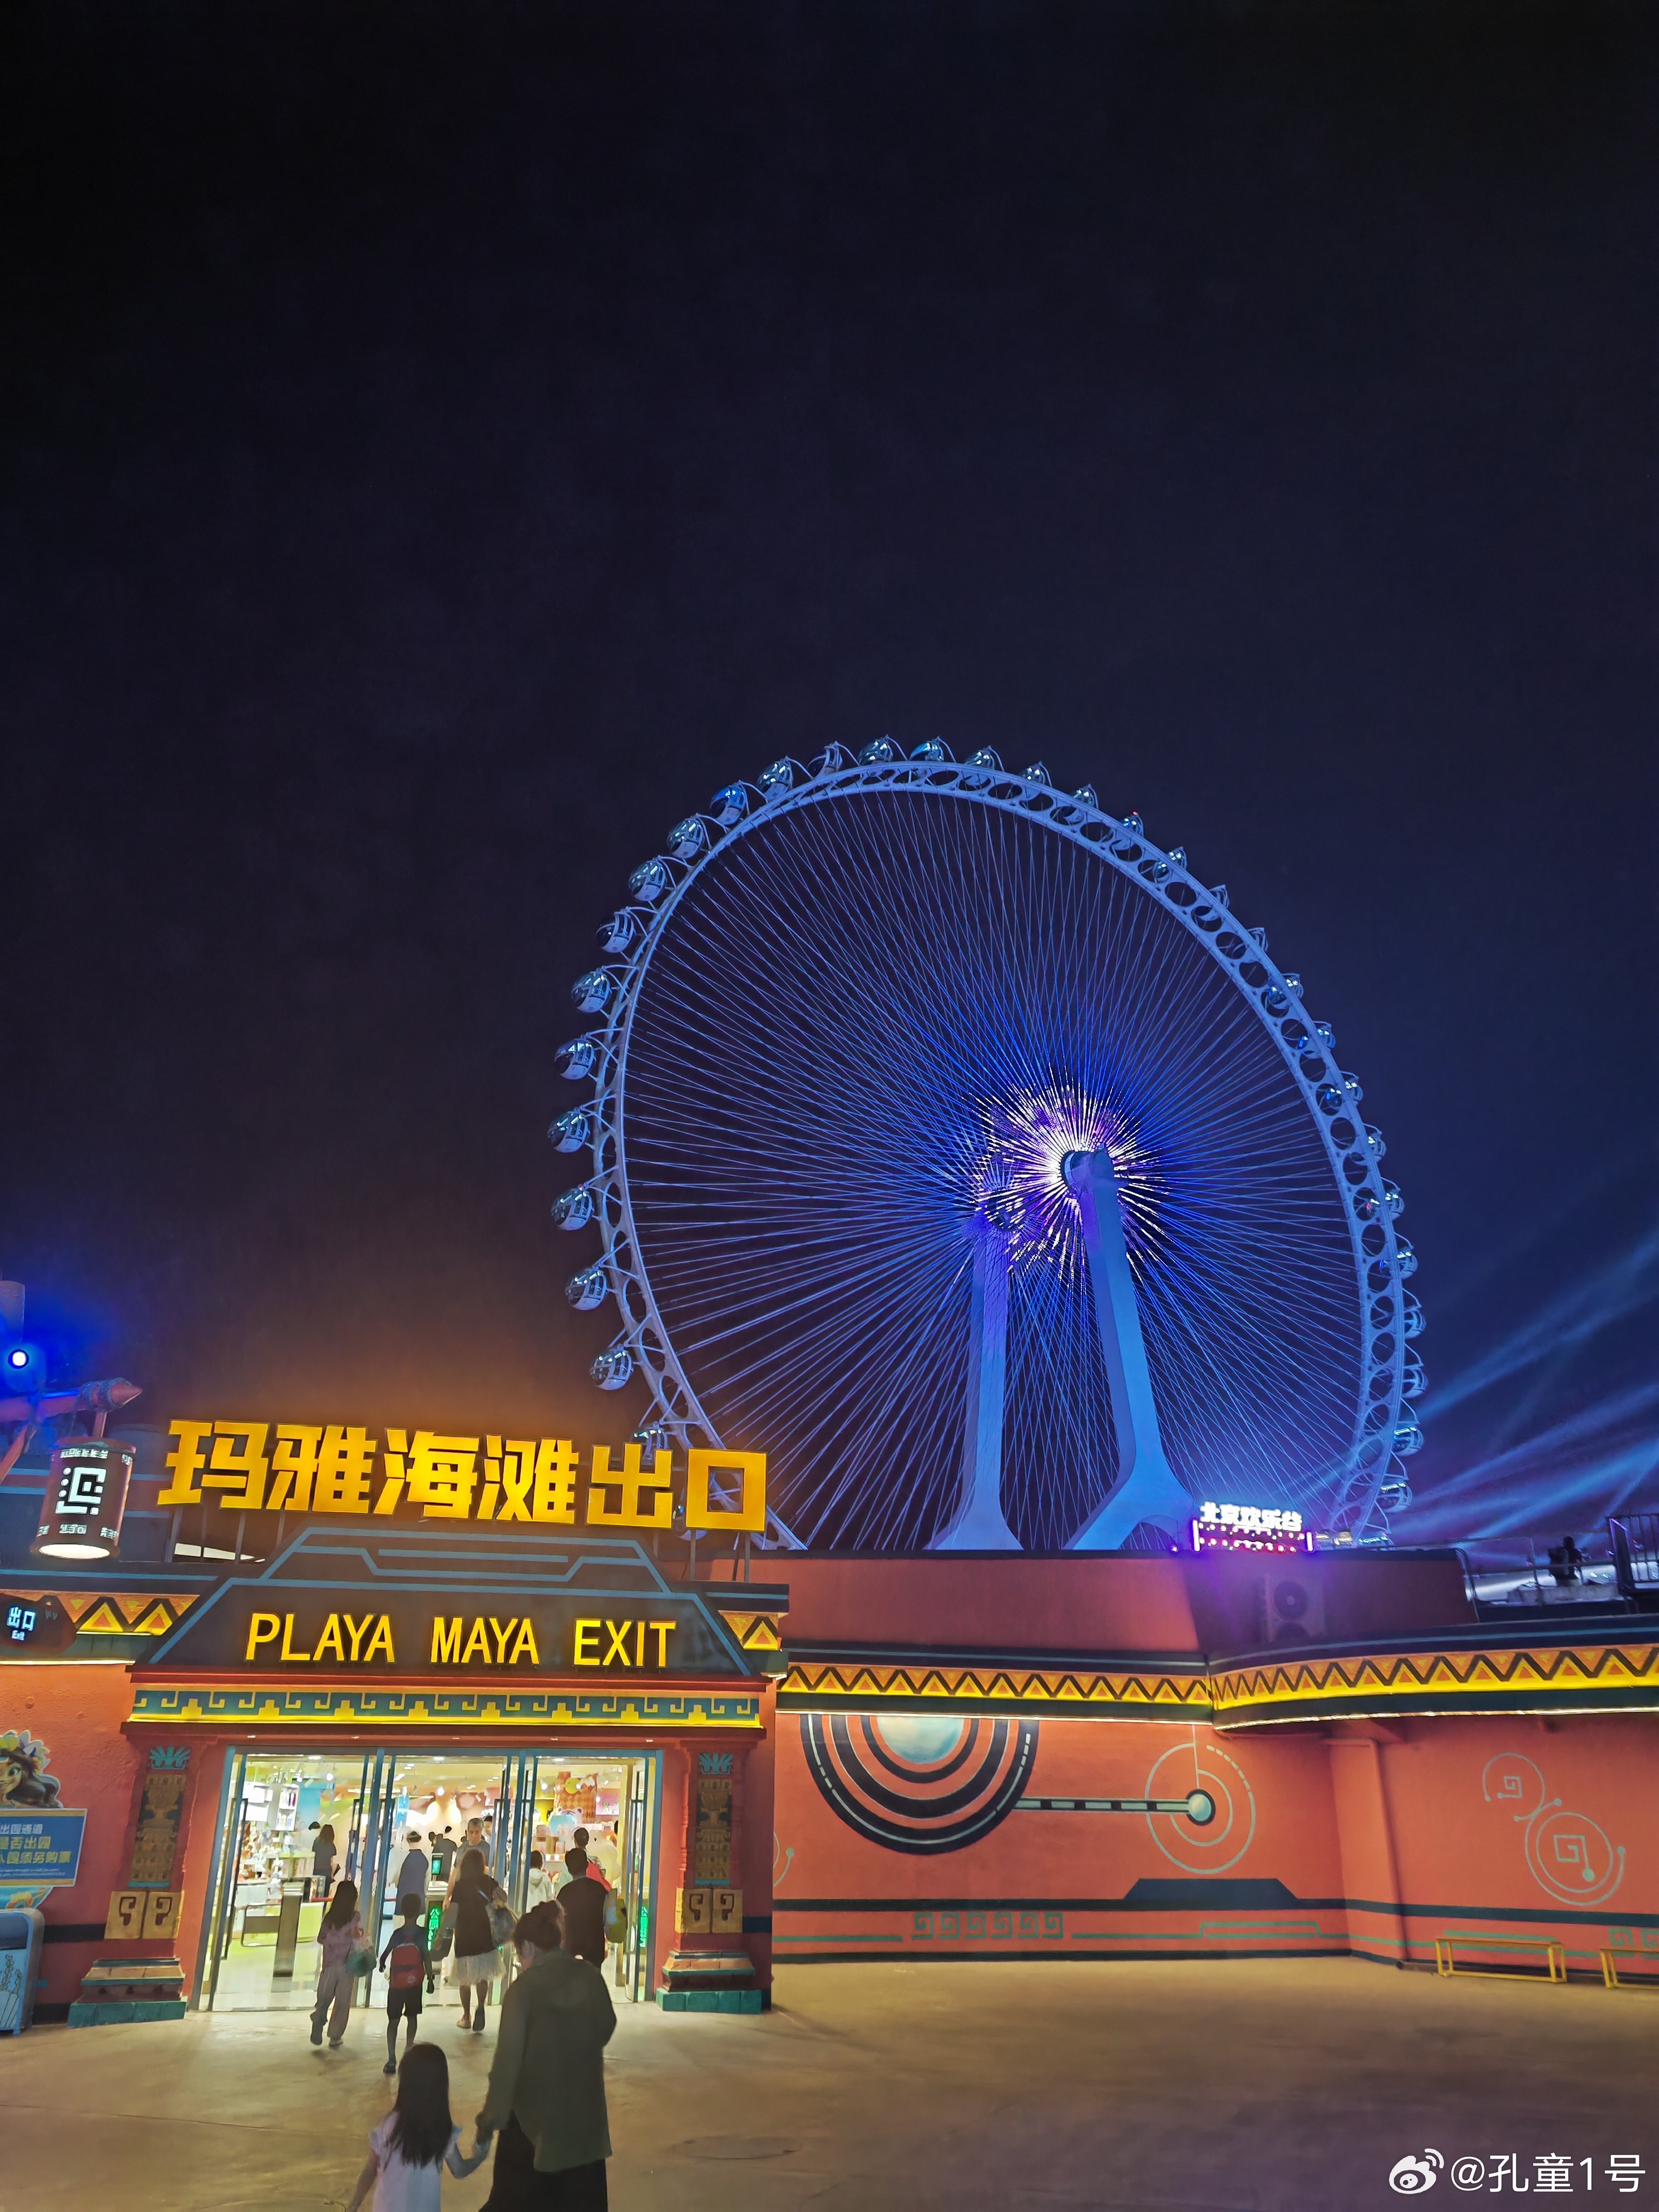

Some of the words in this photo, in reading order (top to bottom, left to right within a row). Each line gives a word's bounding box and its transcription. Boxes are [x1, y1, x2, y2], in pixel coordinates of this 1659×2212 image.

[157, 1420, 767, 1532] 玛雅海滩出口
[1199, 1501, 1302, 1532] 北京欢乐谷
[7, 1607, 36, 1631] 出口
[245, 1613, 395, 1663] PLAYA
[430, 1617, 539, 1664] MAYA
[574, 1620, 676, 1667] EXIT
